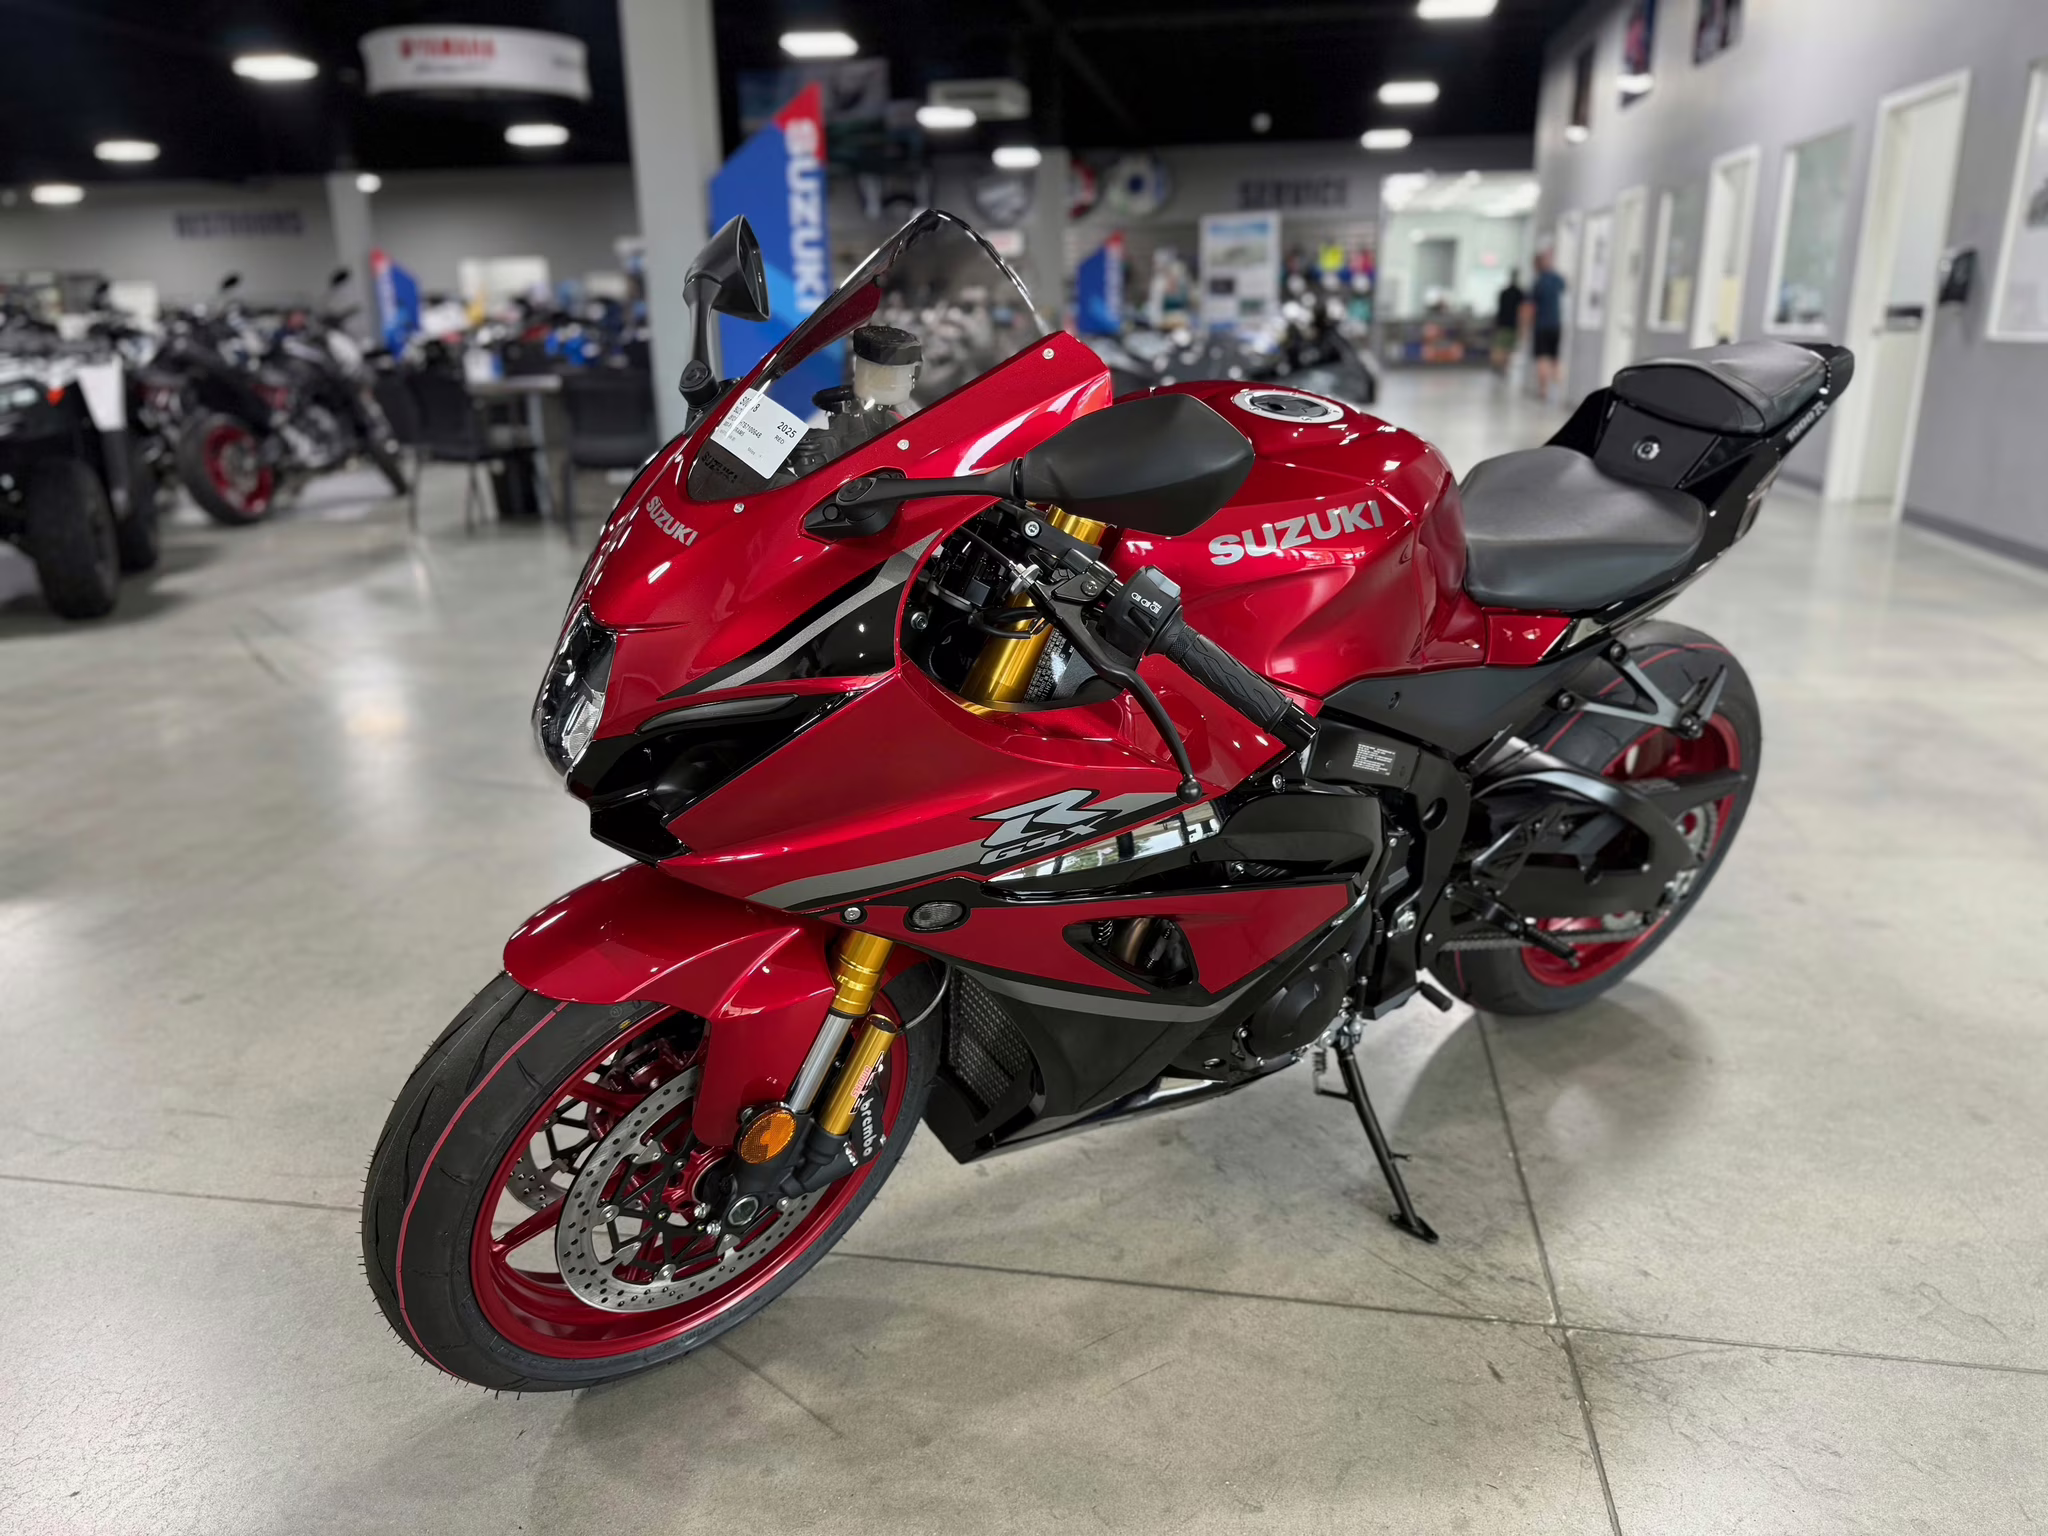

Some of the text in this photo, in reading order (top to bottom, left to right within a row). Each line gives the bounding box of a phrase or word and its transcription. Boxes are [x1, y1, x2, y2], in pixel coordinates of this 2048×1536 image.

[784, 117, 827, 313] SUZUKI
[774, 434, 785, 445] RED
[776, 421, 798, 439] 2025
[645, 495, 699, 547] SUZUKI
[1208, 500, 1384, 567] SUZUKI
[859, 1097, 878, 1158] brembo
